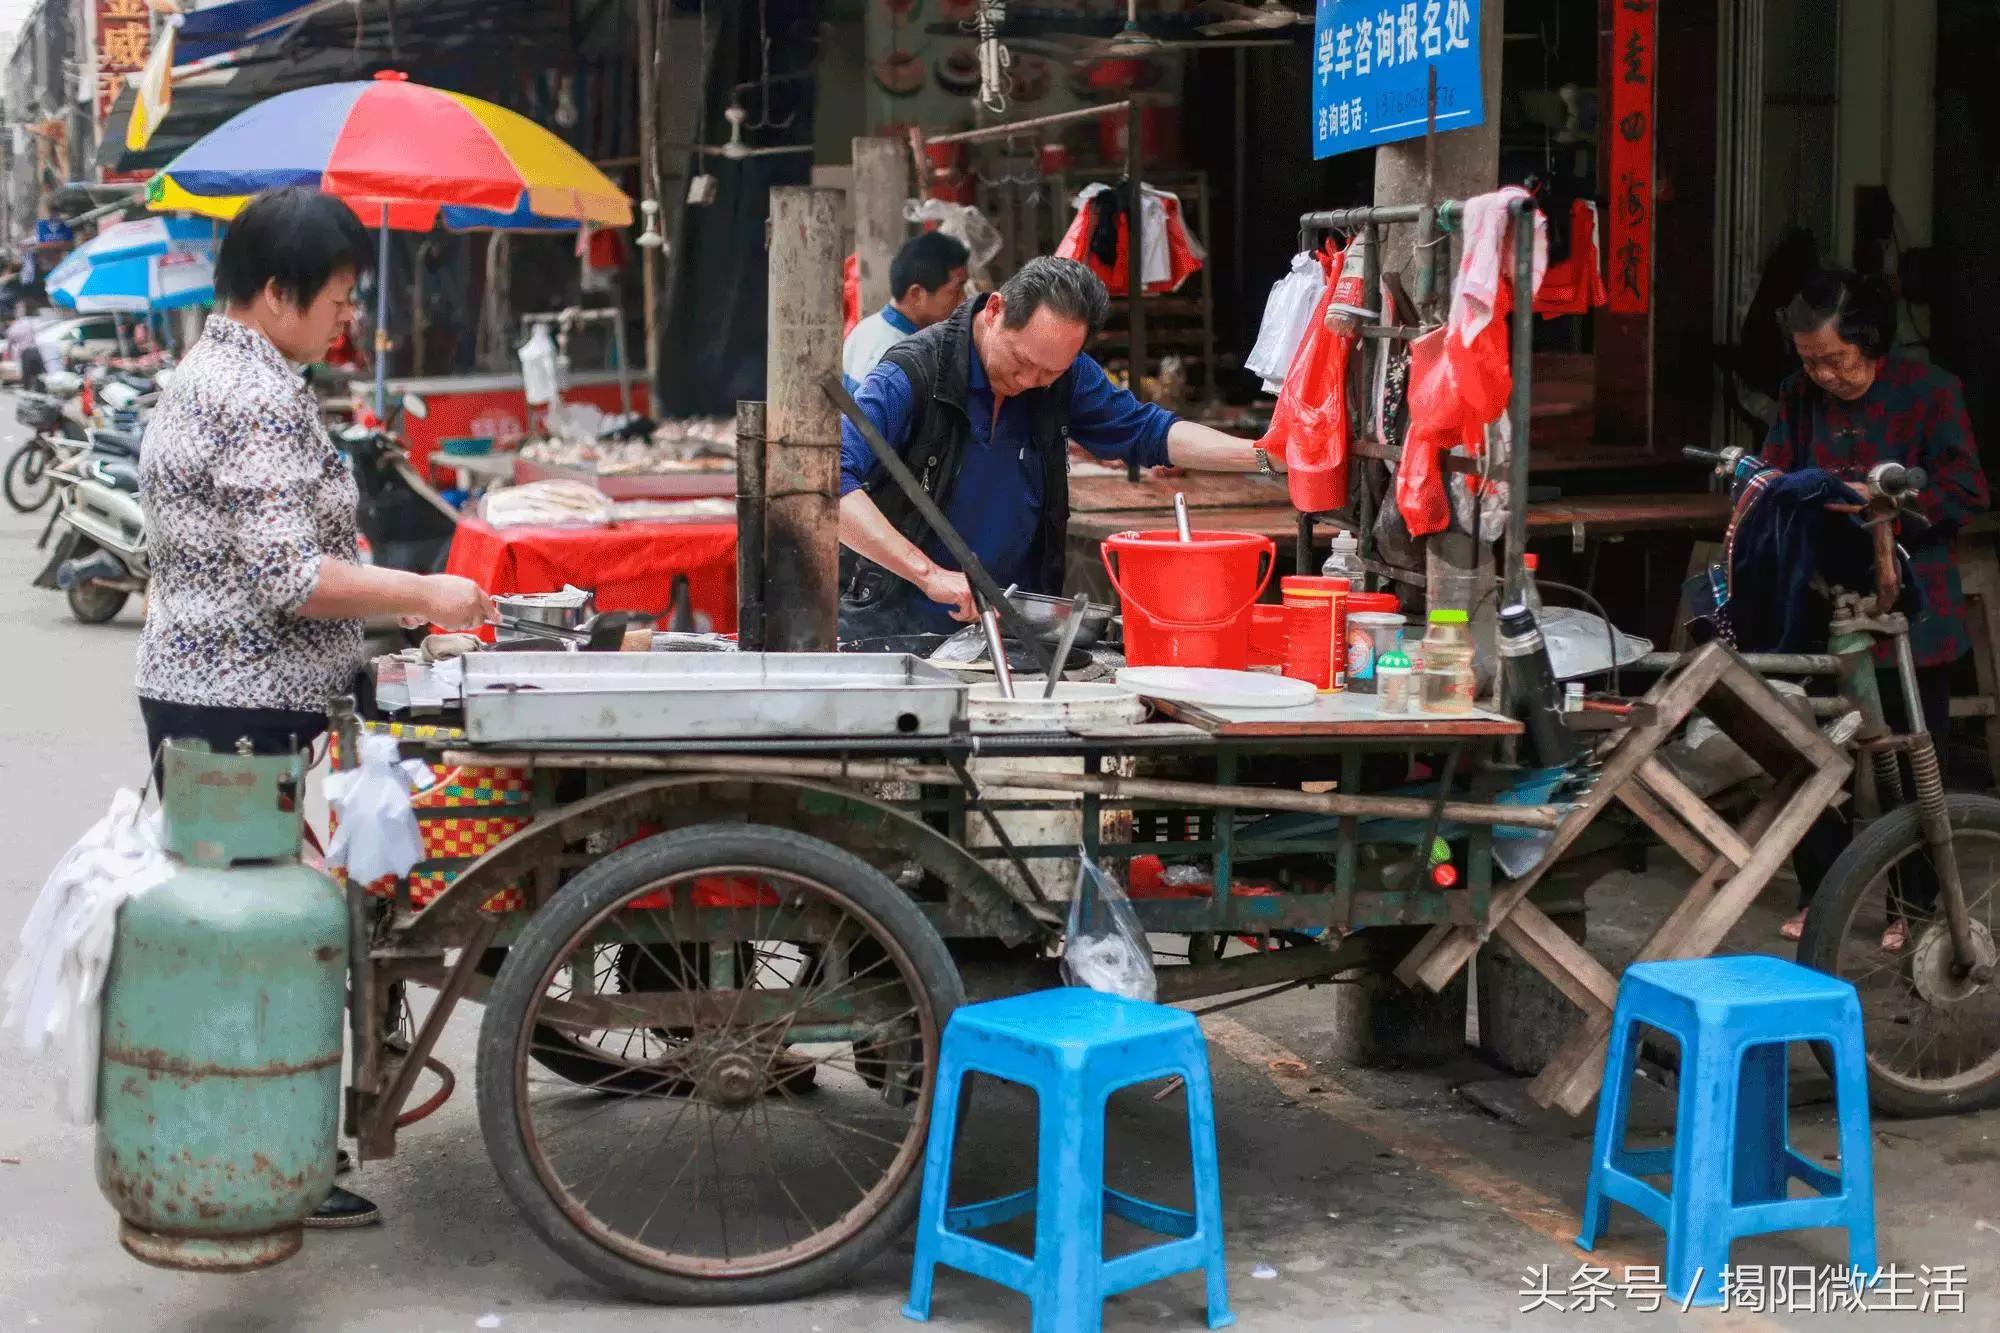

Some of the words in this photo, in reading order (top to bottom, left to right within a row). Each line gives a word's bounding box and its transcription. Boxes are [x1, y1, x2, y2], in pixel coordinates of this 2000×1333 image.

[1318, 0, 1471, 86] 学车咨询报名处
